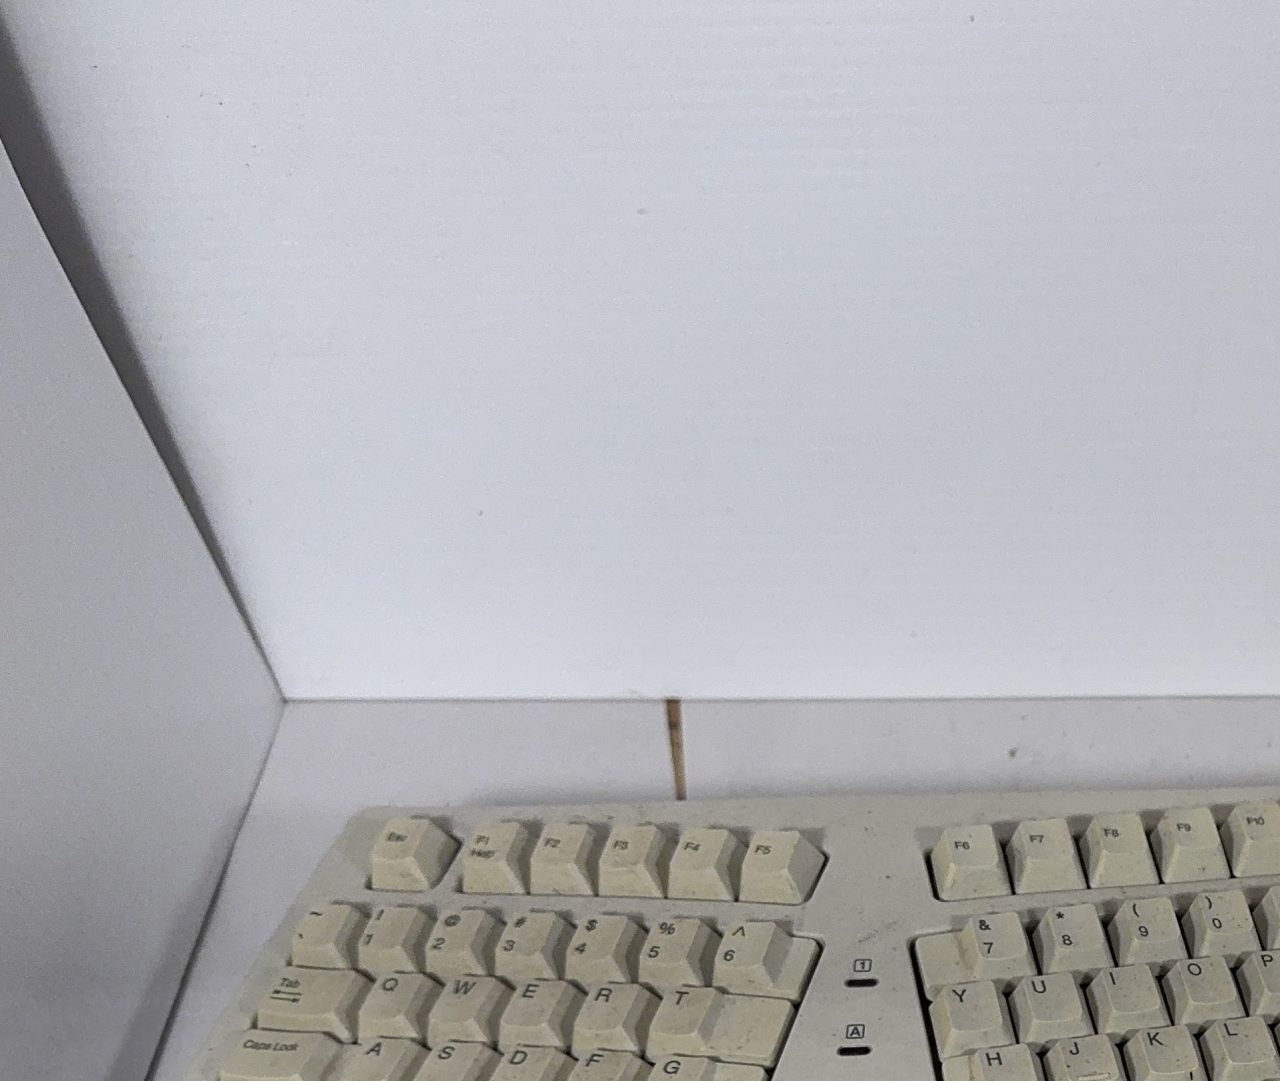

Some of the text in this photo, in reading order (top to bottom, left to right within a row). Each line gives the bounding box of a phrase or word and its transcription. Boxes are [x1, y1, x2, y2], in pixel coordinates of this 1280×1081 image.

[1246, 815, 1265, 826] F10
[1103, 828, 1120, 839] F8
[1176, 822, 1192, 834] F9
[543, 837, 561, 849] F2
[613, 840, 629, 851] F3
[953, 841, 971, 851] F6
[1029, 834, 1045, 844] F7
[683, 842, 701, 853] F4
[754, 844, 772, 856] F5
[444, 913, 461, 928] @
[585, 918, 599, 933] $
[978, 918, 992, 932] &
[659, 921, 676, 936] %
[1137, 925, 1149, 938] 9
[363, 933, 374, 946] 1
[431, 937, 446, 950] 2
[503, 939, 516, 952] 3
[1061, 933, 1073, 947] 8
[573, 942, 588, 955] 4
[647, 945, 661, 959] 5
[983, 941, 994, 955] 7
[722, 948, 736, 963] 6
[1260, 954, 1275, 968] P
[1186, 962, 1203, 977] O
[279, 977, 301, 988] Tab
[382, 977, 399, 993] Q
[453, 980, 477, 995] W
[1031, 979, 1047, 994] U
[522, 983, 540, 999] E
[594, 988, 613, 1003] R
[675, 990, 690, 1006] T
[951, 988, 968, 1003] Y
[1223, 1022, 1239, 1036] L
[1147, 1031, 1164, 1047] K
[242, 1041, 299, 1055] Caps Lock
[365, 1042, 383, 1057] A
[437, 1046, 456, 1061] S
[1068, 1041, 1081, 1056] J
[508, 1049, 529, 1065] D
[585, 1053, 604, 1068] F
[985, 1051, 1003, 1067] H
[663, 1060, 682, 1075] G
